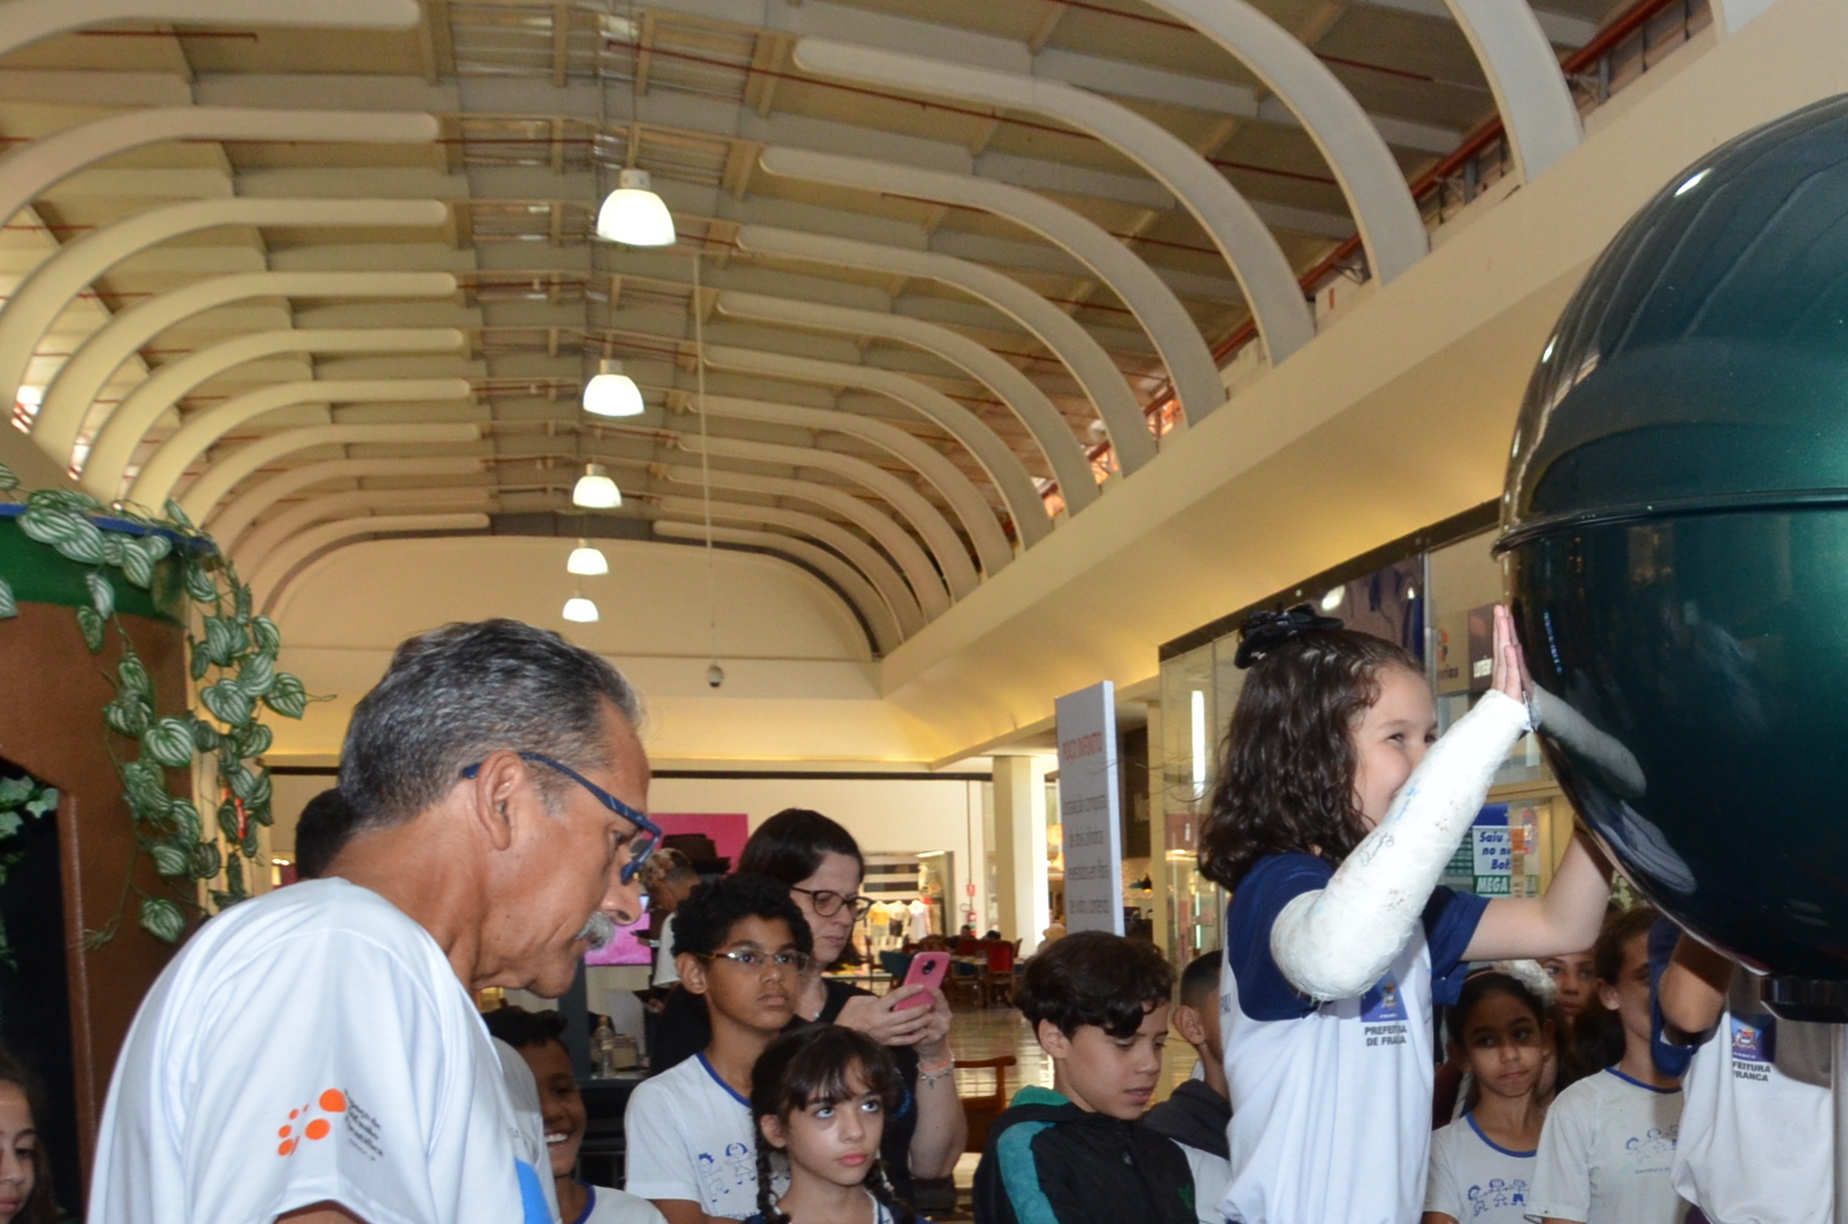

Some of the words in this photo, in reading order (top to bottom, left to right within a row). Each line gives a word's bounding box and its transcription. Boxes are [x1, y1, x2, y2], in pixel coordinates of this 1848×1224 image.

[1476, 877, 1508, 893] MEGA
[1366, 1037, 1379, 1047] DE
[1732, 1061, 1771, 1073] FEITURA
